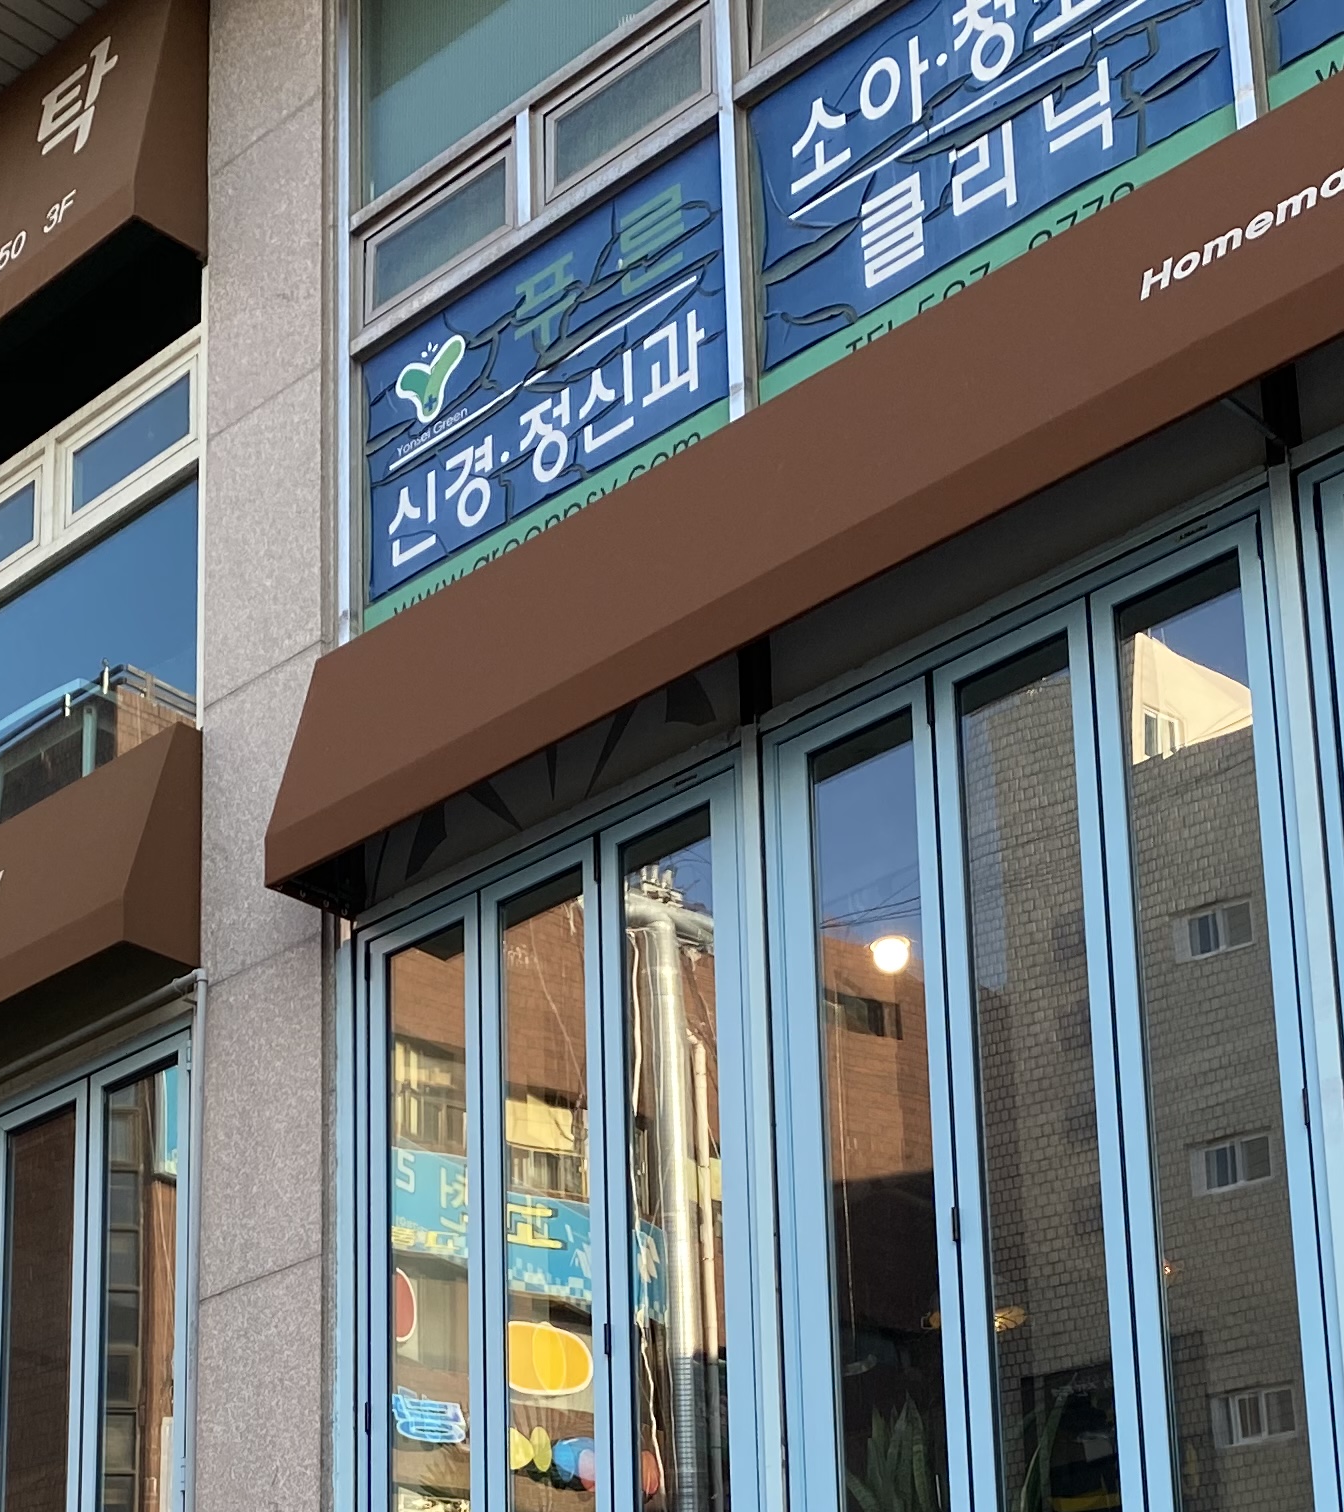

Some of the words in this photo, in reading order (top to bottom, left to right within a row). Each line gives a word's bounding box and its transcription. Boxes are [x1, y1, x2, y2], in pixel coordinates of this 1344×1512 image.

[43, 189, 77, 235] 3F
[860, 57, 1113, 290] 클리닉
[514, 183, 685, 348] 푸른
[388, 309, 706, 568] 신경·정신과
[396, 428, 432, 457] Yonsei
[433, 406, 469, 435] Green
